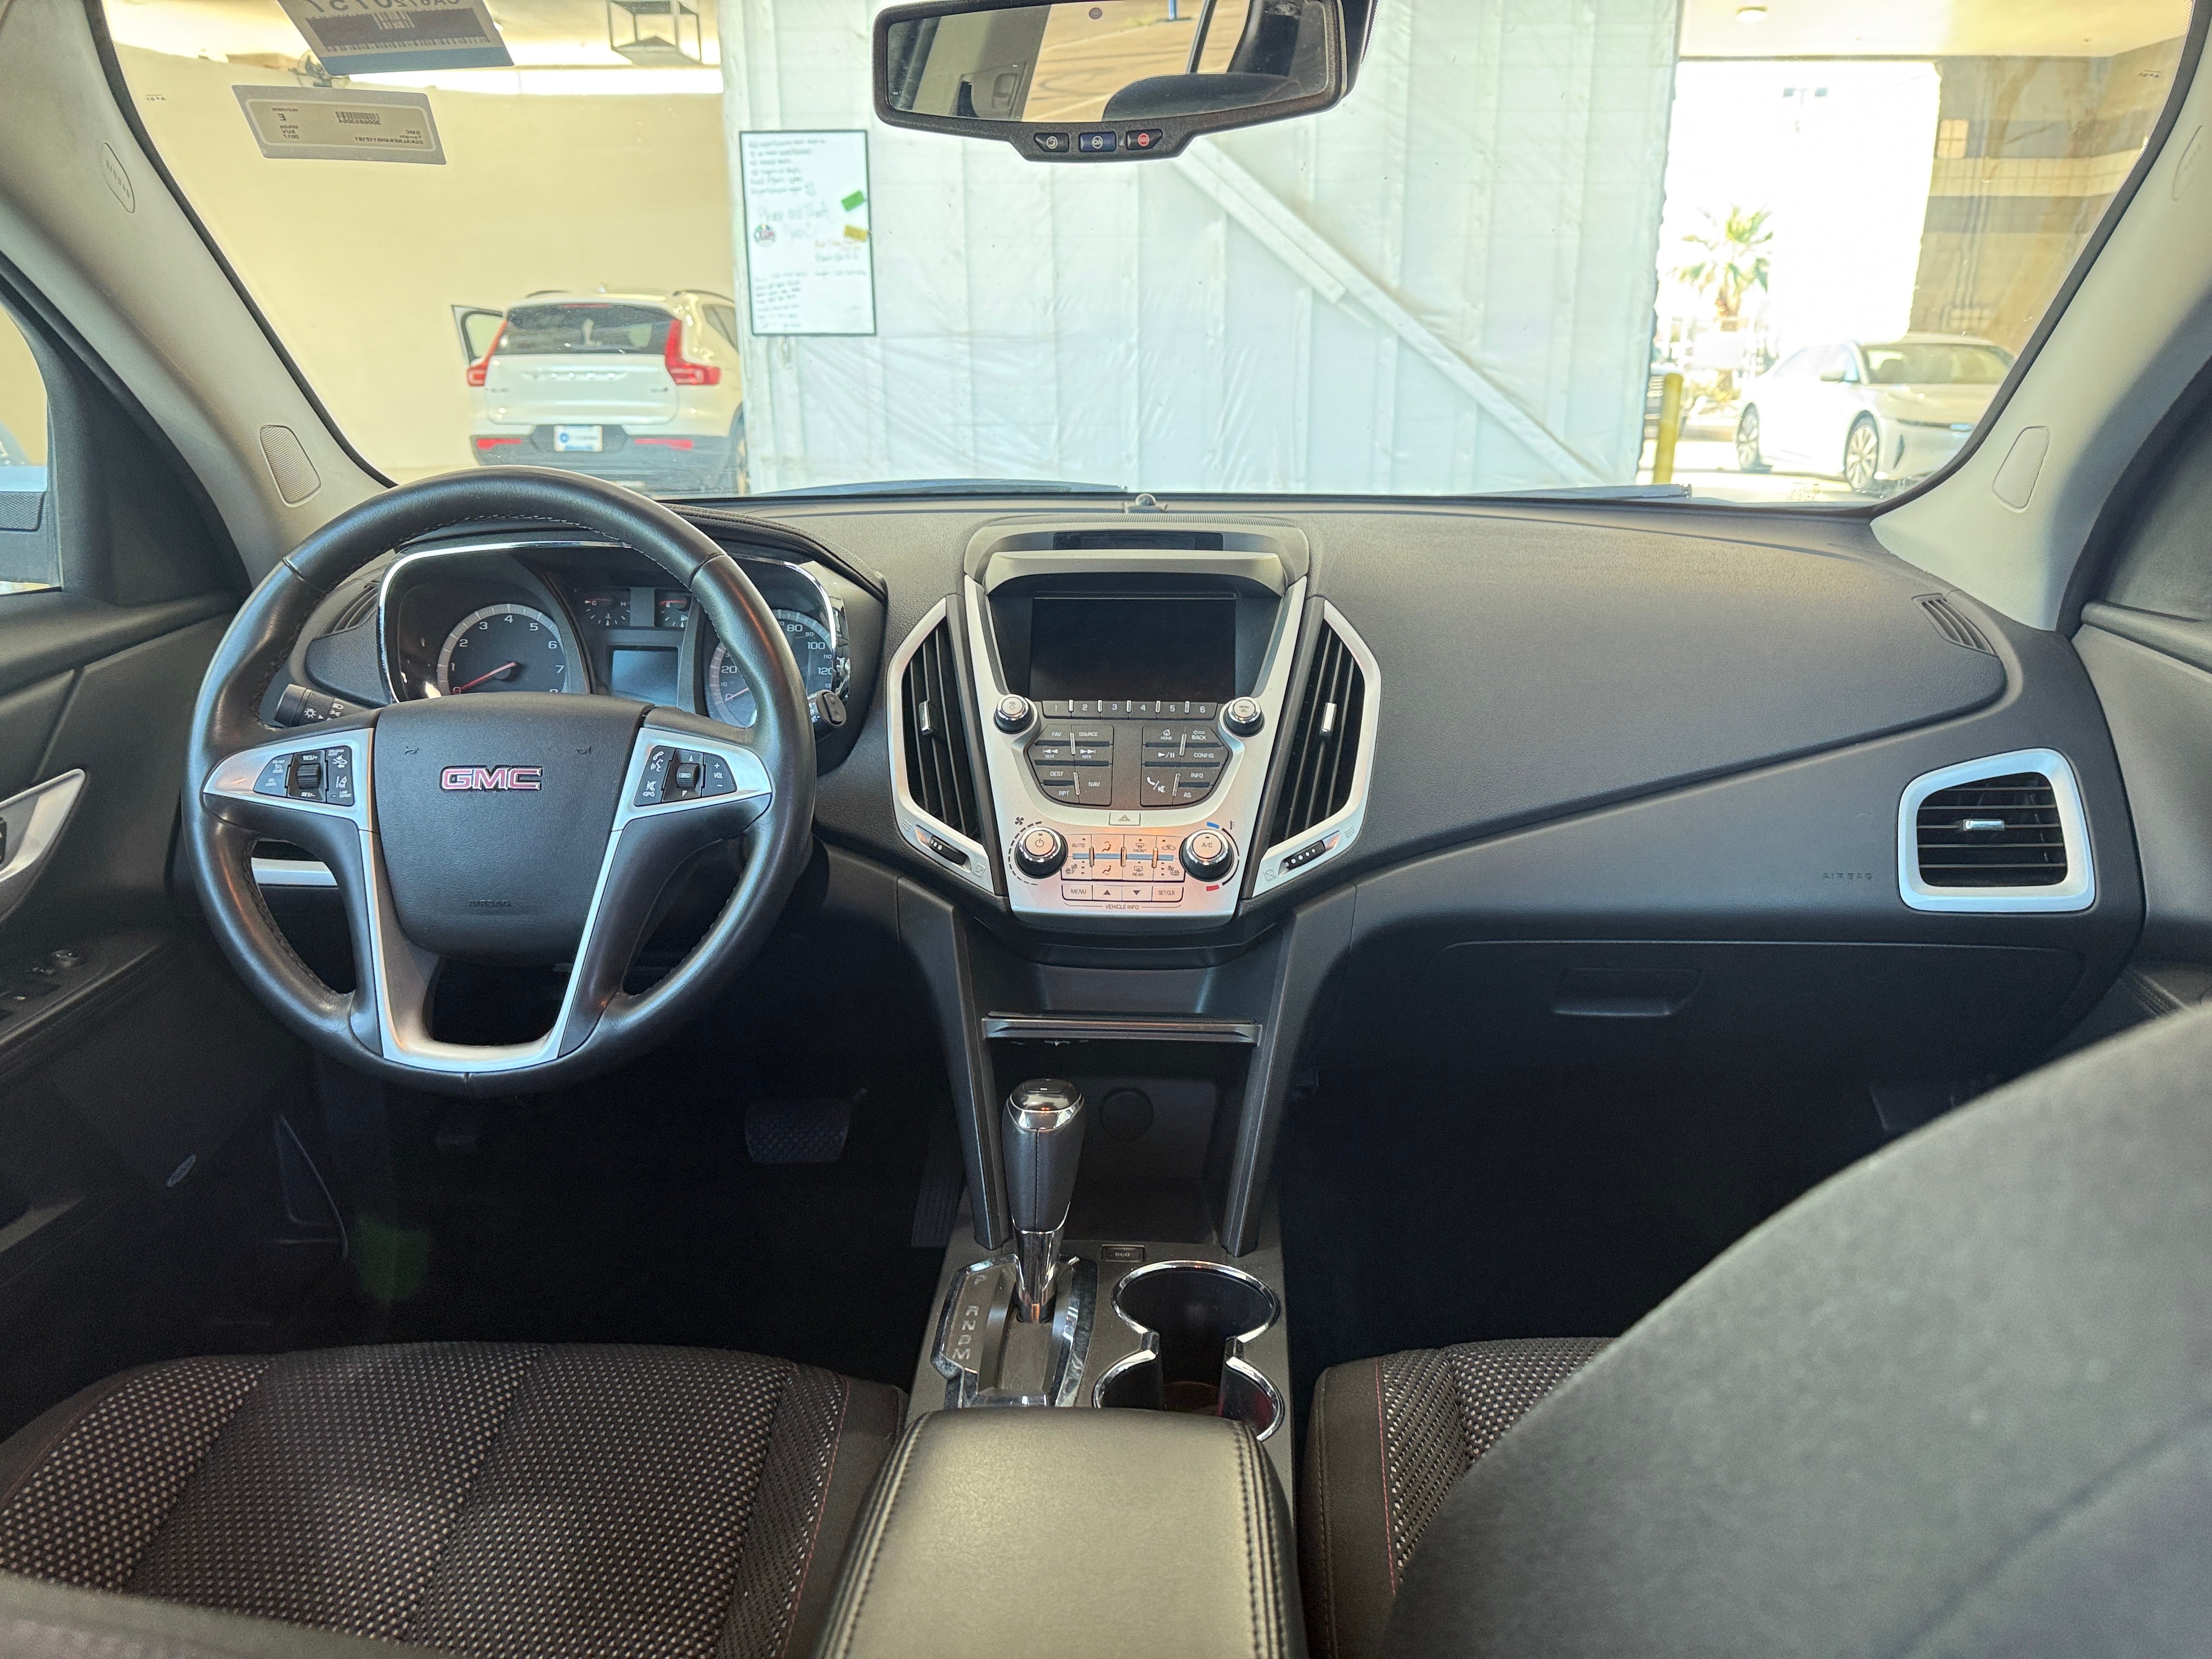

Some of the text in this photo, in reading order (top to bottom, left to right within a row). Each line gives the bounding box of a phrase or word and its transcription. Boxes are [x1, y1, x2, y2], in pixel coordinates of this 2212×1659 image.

[504, 614, 514, 624] 4
[479, 621, 488, 630] 3
[529, 622, 539, 631] 5
[786, 624, 803, 632] 80
[459, 638, 469, 647] 2
[548, 640, 558, 650] 6
[807, 641, 826, 650] 100
[450, 662, 455, 671] 1
[555, 664, 565, 674] 7
[441, 767, 541, 791] GMC
[974, 1274, 986, 1286] P
[965, 1305, 980, 1317] R
[961, 1319, 977, 1331] N
[957, 1334, 972, 1346] D
[952, 1348, 971, 1360] M
